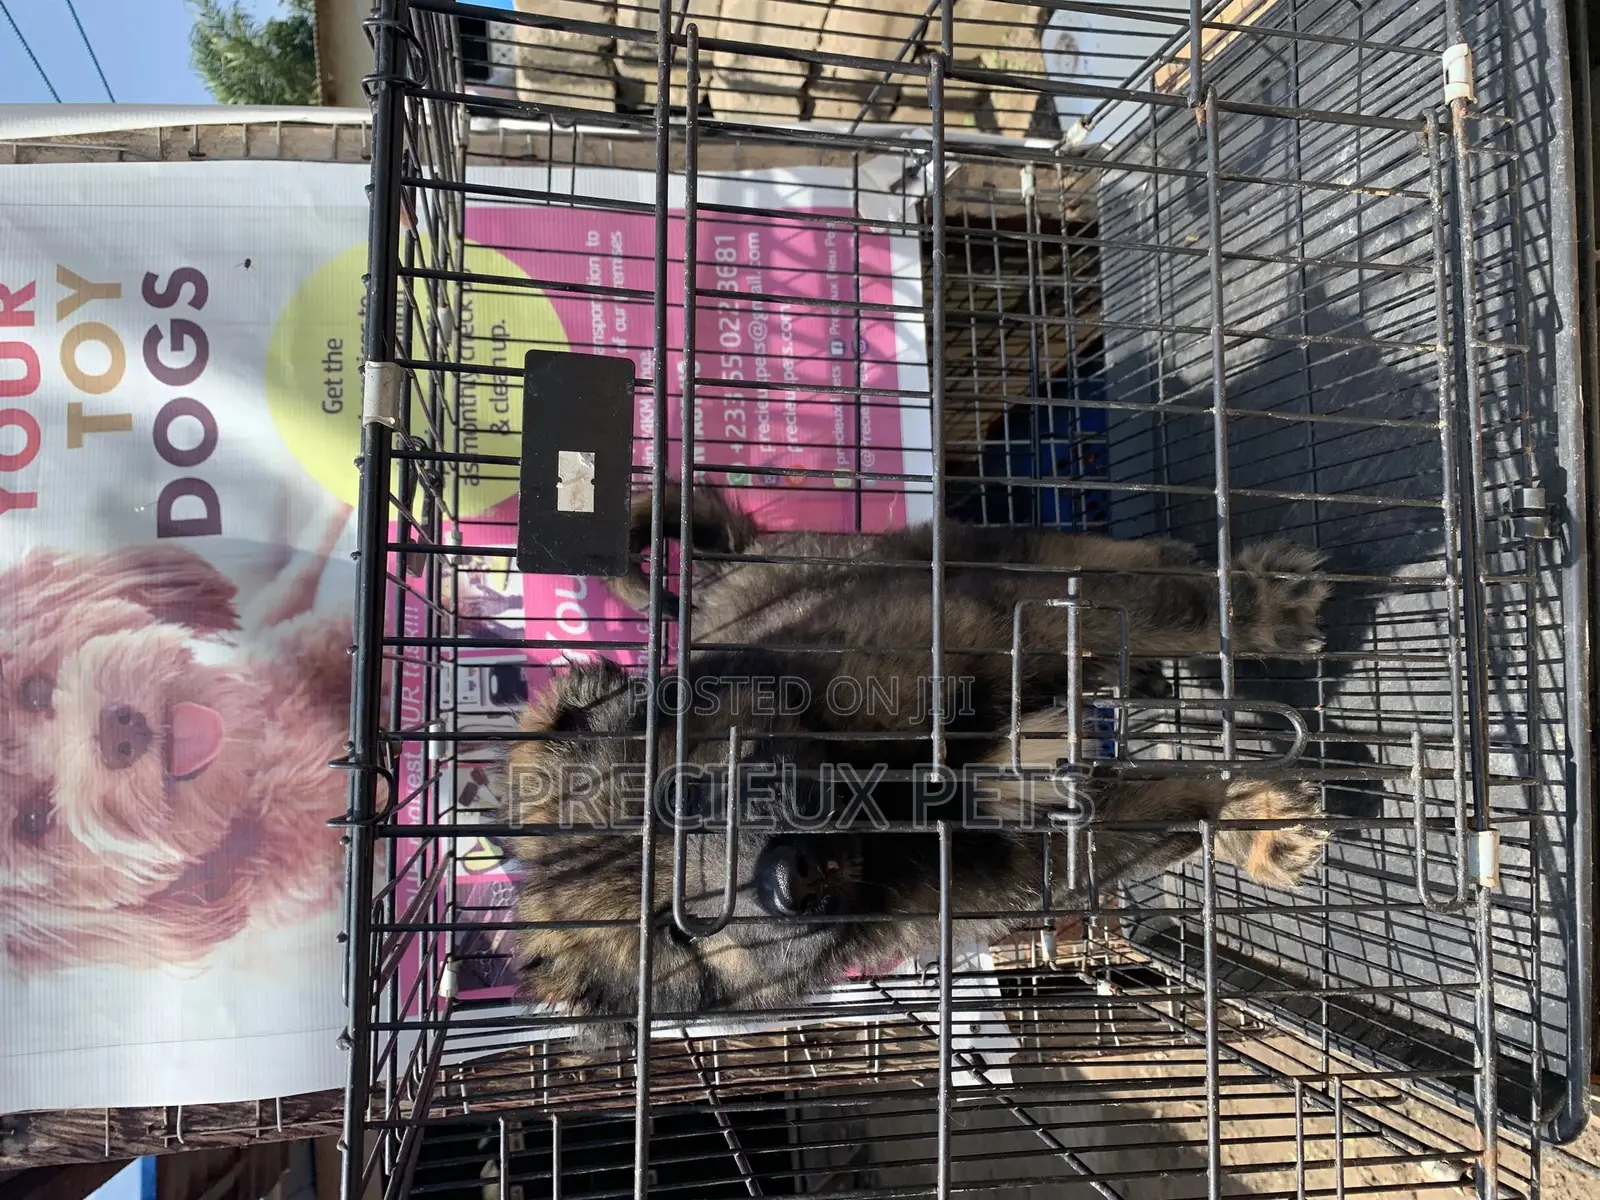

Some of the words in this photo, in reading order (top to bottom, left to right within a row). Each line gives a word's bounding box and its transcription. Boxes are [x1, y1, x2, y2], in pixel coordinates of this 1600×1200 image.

[585, 230, 600, 247] to
[714, 235, 740, 292] 3681
[490, 319, 511, 352] up.
[613, 306, 627, 332] our
[718, 301, 742, 348] 022
[745, 231, 777, 453] precieupes@gmail.com
[56, 264, 134, 449] TOY
[321, 337, 343, 373] the
[778, 302, 804, 453] precieupes.com
[0, 280, 41, 515] YOUR
[141, 266, 222, 540] DOGS
[321, 378, 343, 414] Get
[457, 370, 481, 456] monthy
[488, 357, 509, 414] clean
[489, 419, 510, 436] &
